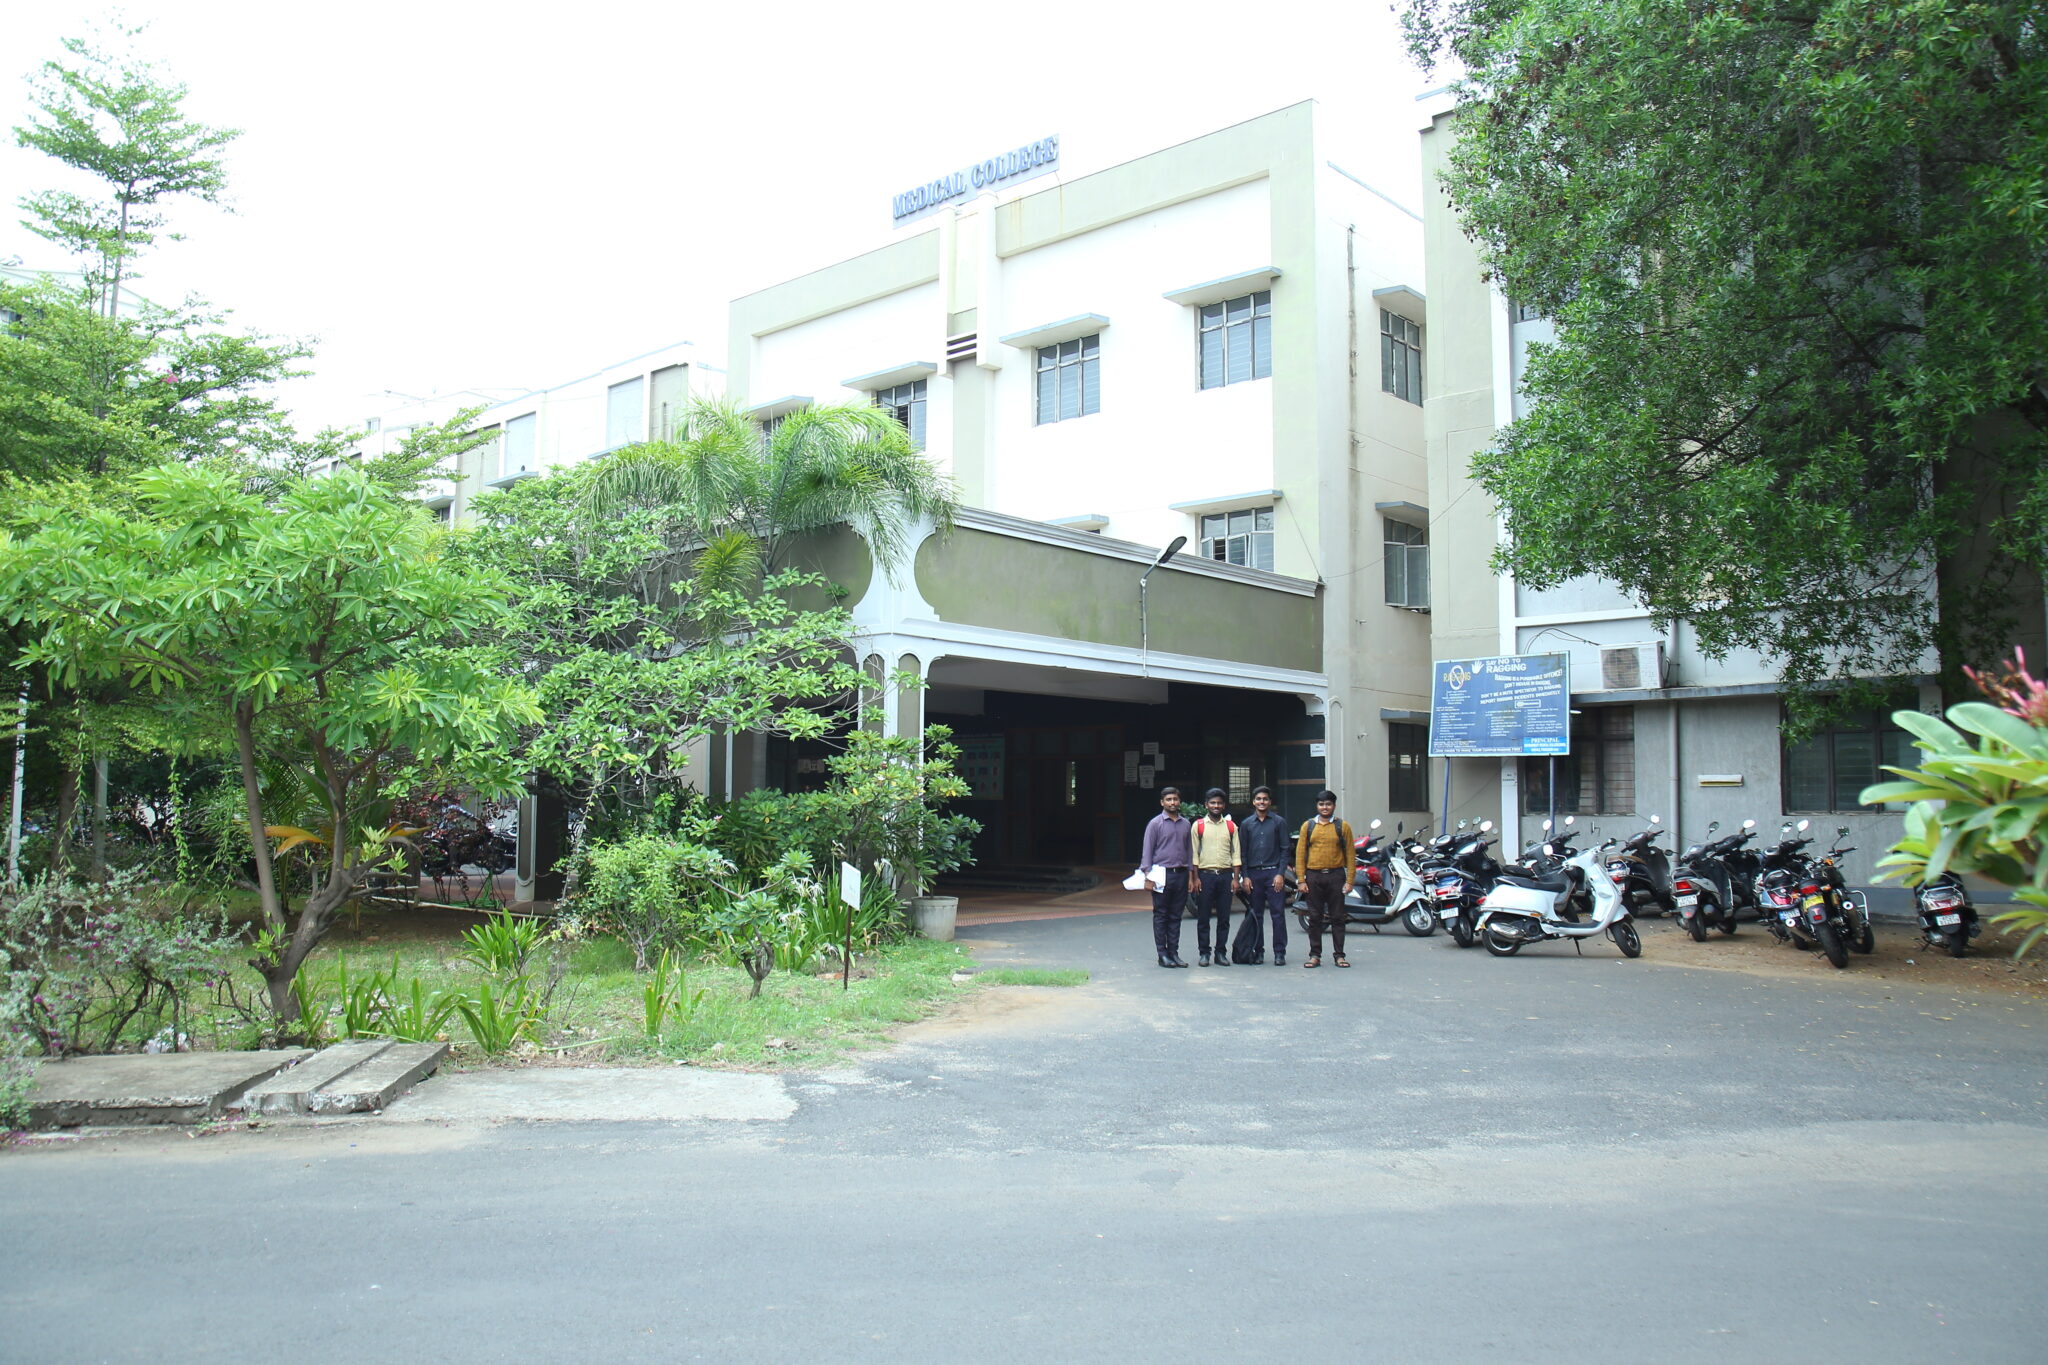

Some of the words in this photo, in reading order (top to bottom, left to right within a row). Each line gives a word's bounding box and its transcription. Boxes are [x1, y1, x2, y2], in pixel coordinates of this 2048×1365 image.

[893, 172, 966, 220] MEDICAL
[971, 136, 1058, 188] COLLEGE
[1486, 663, 1527, 673] RAGGING
